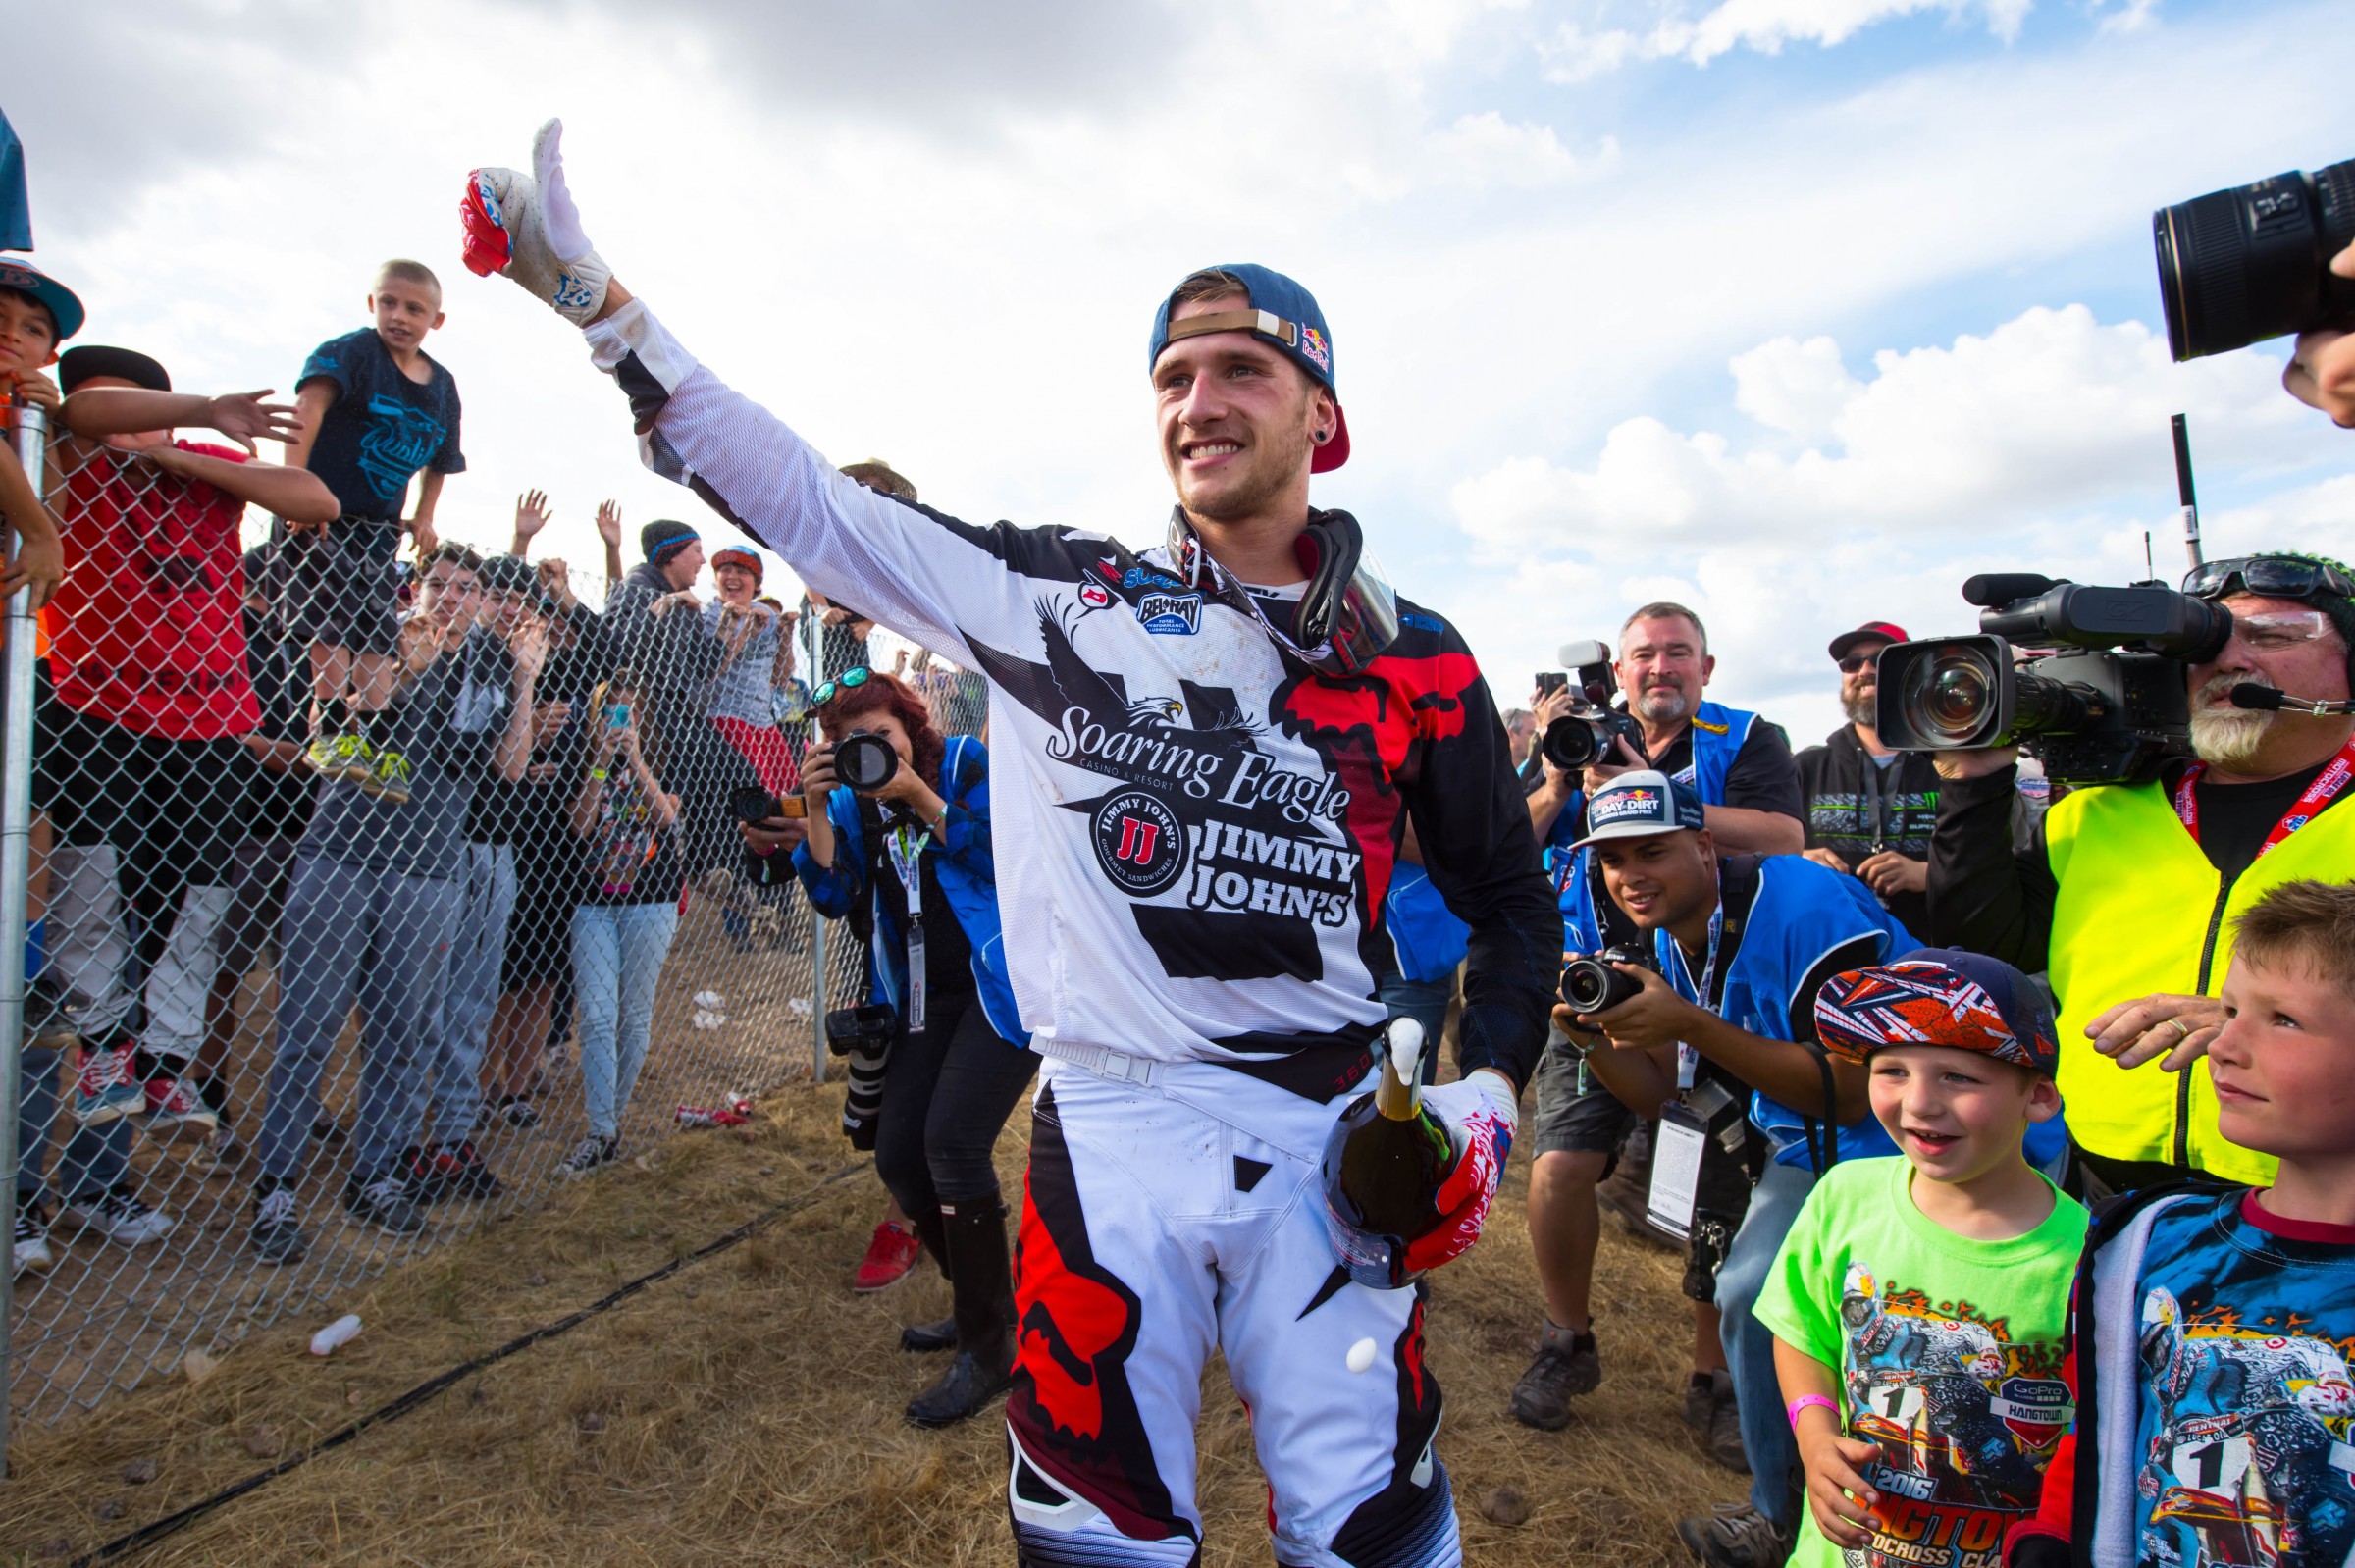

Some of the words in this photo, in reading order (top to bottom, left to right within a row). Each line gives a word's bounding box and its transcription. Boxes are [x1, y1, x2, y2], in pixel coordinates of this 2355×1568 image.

[1046, 706, 1224, 799] Soaring
[1217, 750, 1351, 823] Eagle
[1079, 758, 1119, 776] CASINO
[1133, 773, 1174, 792] RESORT
[2303, 758, 2348, 803] MOTOCROSS
[1101, 798, 1140, 833] JIMMY
[1143, 801, 1177, 850] JOHN'S
[1601, 800, 1625, 814] DAY
[1627, 799, 1659, 810] DIRT
[1101, 838, 1126, 877] GOURMET
[1127, 857, 1173, 882] SANDWICHES
[1117, 815, 1159, 865] JJ
[1198, 818, 1361, 883] JIMMY
[1191, 863, 1349, 923] JOHN'S
[1605, 952, 1626, 961] Nikon
[1334, 1053, 1371, 1094] 360
[1882, 1387, 1906, 1419] 1
[2014, 1384, 2063, 1395] GoPro
[2008, 1404, 2063, 1421] HANGTOWN
[1874, 1468, 1934, 1499] 2016
[2188, 1441, 2224, 1490] 1
[1853, 1490, 2035, 1551] NGTO
[1871, 1533, 1952, 1565] OCROSS
[1962, 1551, 2004, 1568] CLA
